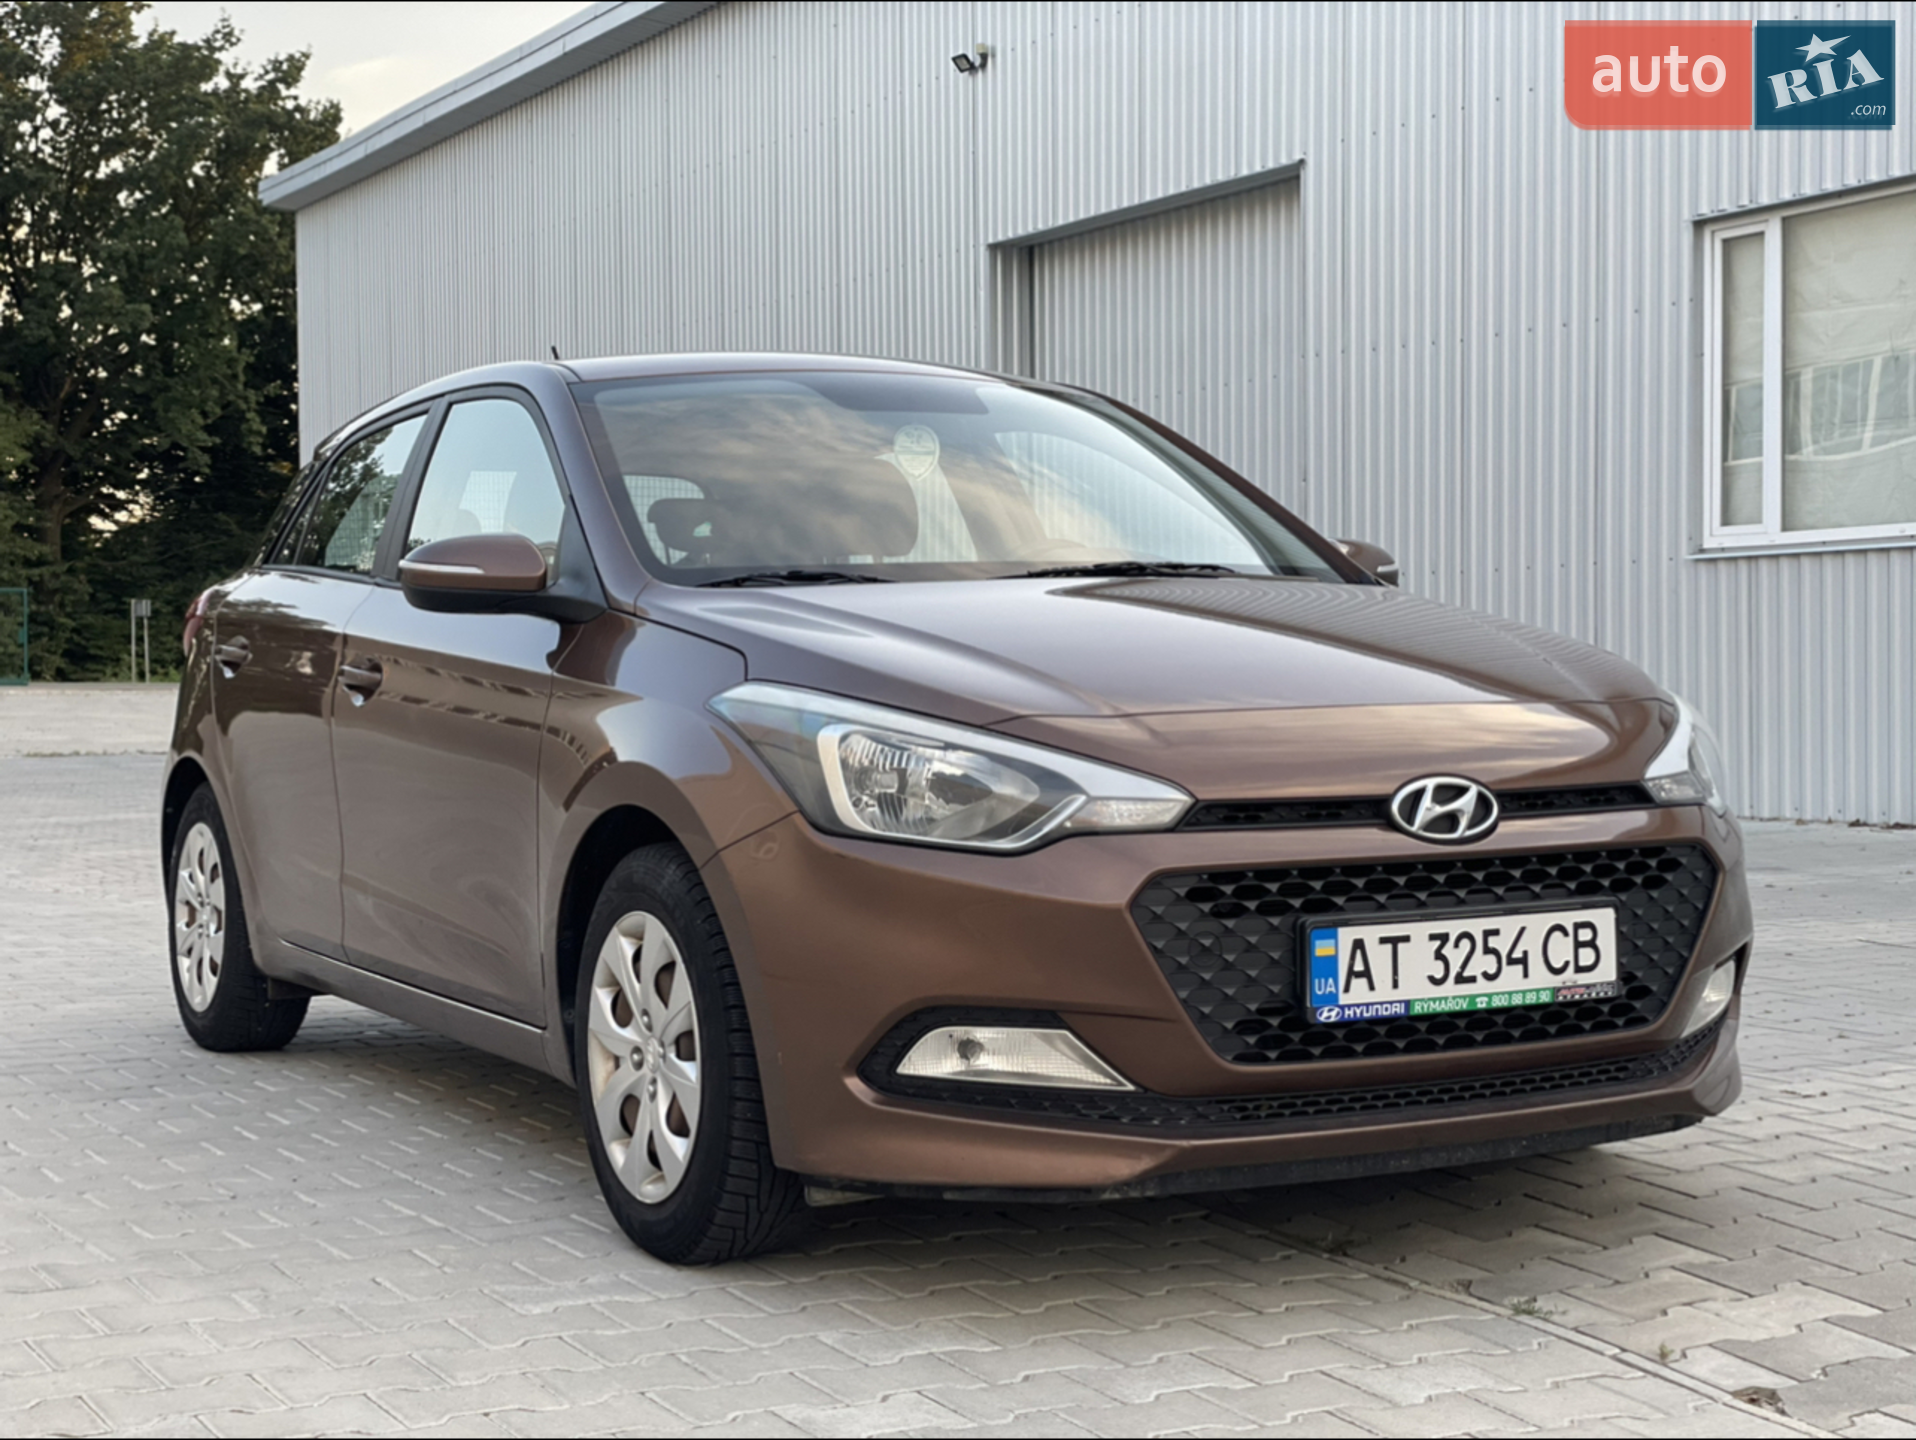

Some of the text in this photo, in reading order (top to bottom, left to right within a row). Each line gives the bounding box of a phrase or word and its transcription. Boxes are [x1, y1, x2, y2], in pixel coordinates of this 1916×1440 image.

[1342, 920, 1601, 994] AT 3254 CB
[1314, 977, 1337, 995] UA
[1343, 1002, 1405, 1019] HYUNDAI
[1491, 993, 1509, 1007] 800
[1539, 989, 1551, 1003] 90
